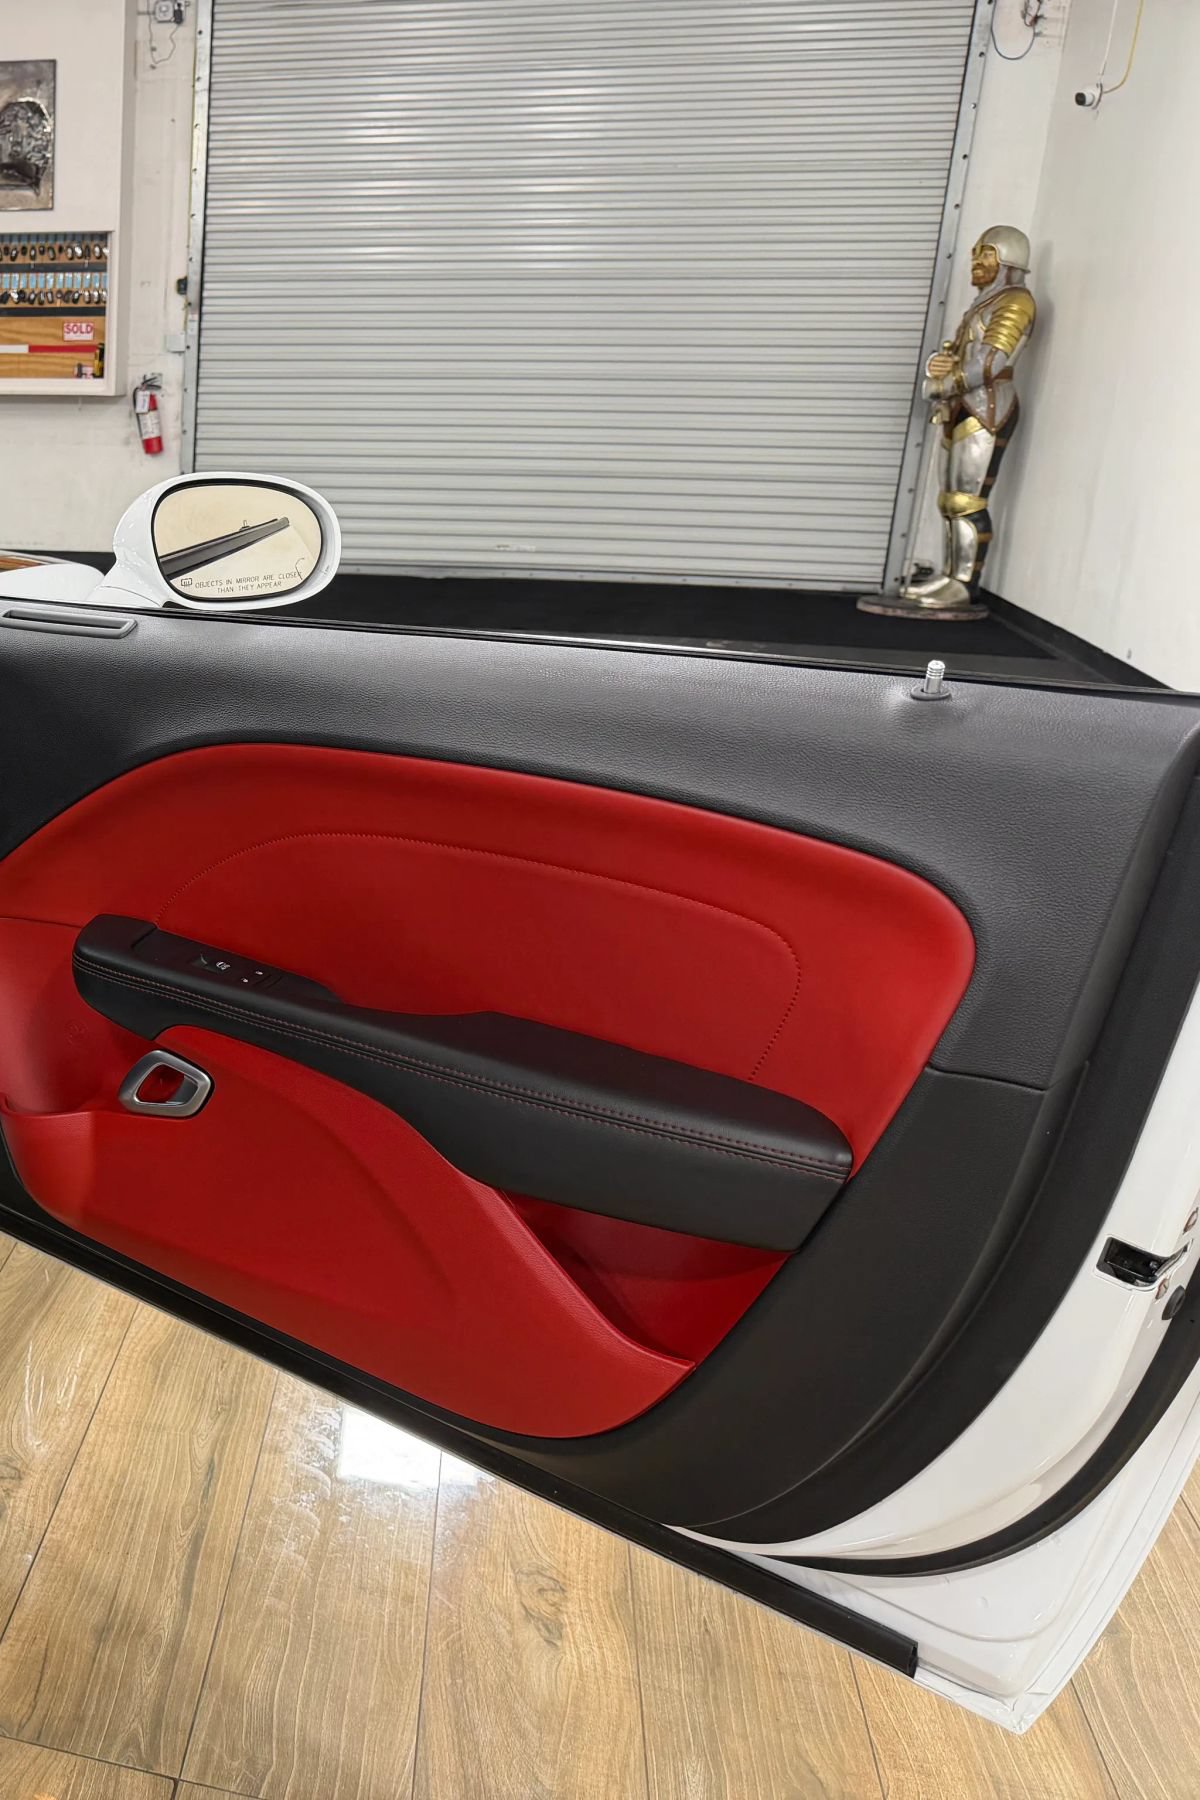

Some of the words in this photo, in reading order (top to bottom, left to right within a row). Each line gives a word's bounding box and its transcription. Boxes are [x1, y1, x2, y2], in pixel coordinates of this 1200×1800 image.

[64, 324, 93, 334] SOLD
[195, 580, 223, 588] OBJECTS
[257, 581, 282, 589] APPEAR
